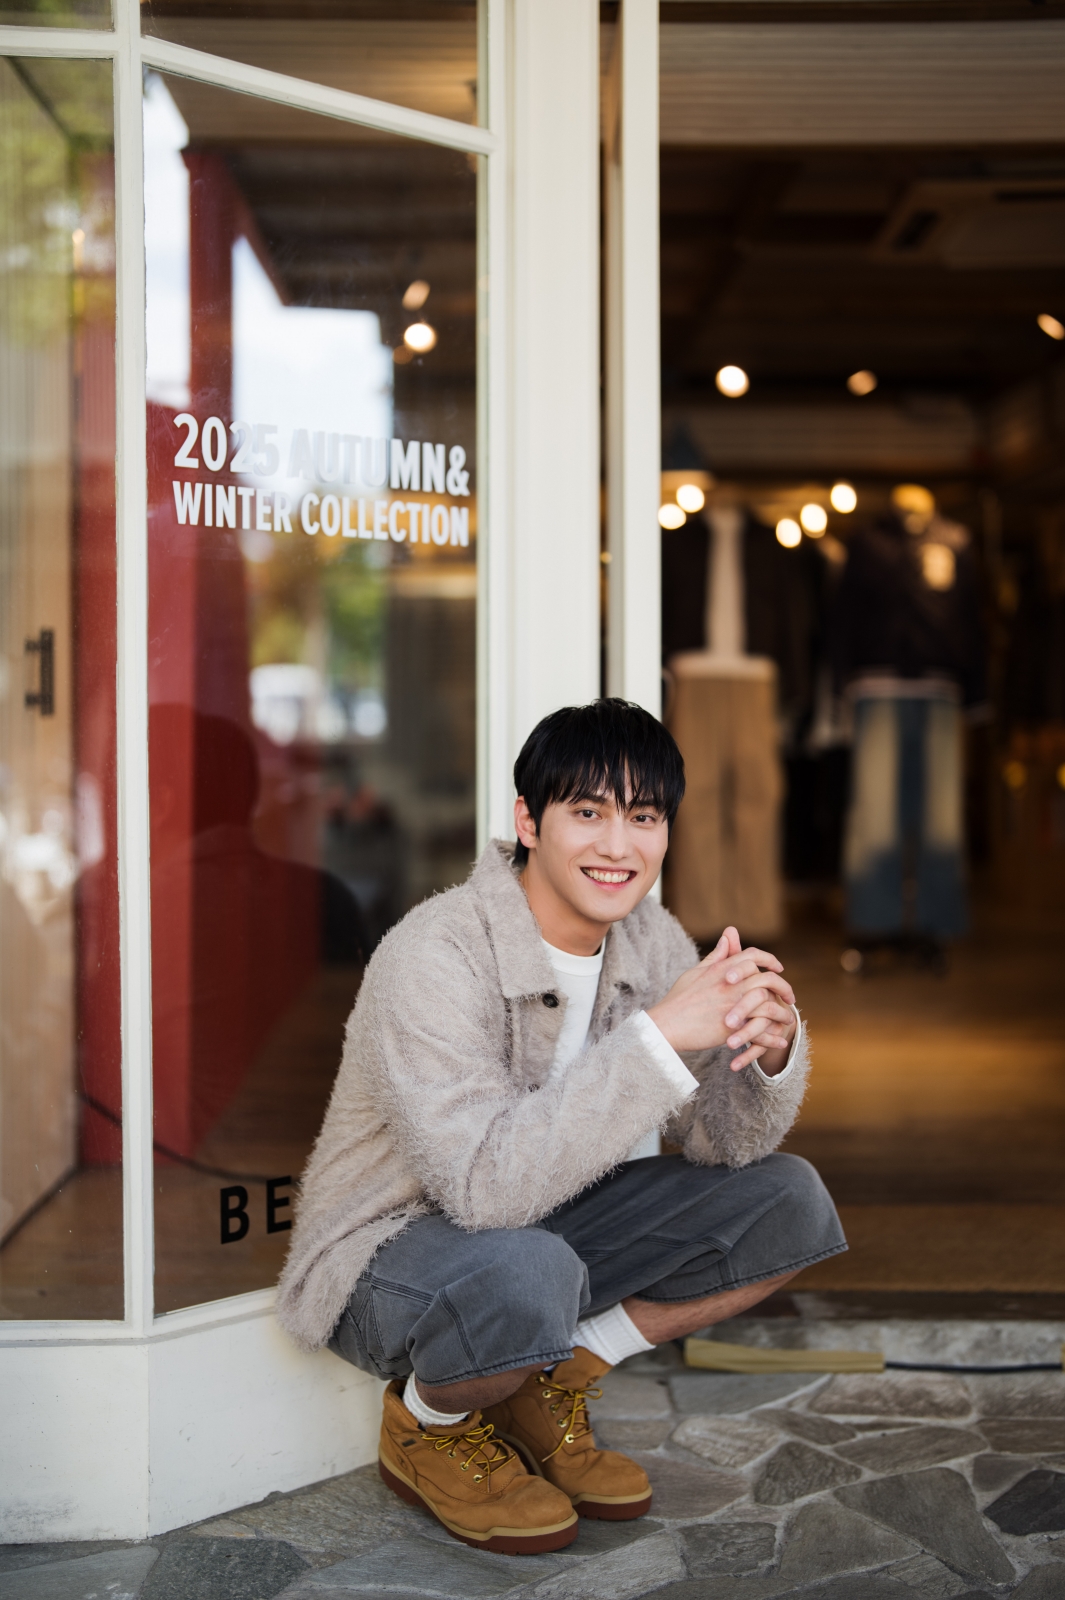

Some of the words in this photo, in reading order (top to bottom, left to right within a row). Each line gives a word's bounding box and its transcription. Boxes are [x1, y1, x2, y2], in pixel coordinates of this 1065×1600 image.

[173, 413, 279, 476] 2025
[172, 481, 293, 533] WINTER
[302, 493, 469, 547] COLLECTION
[220, 1175, 292, 1244] BE
